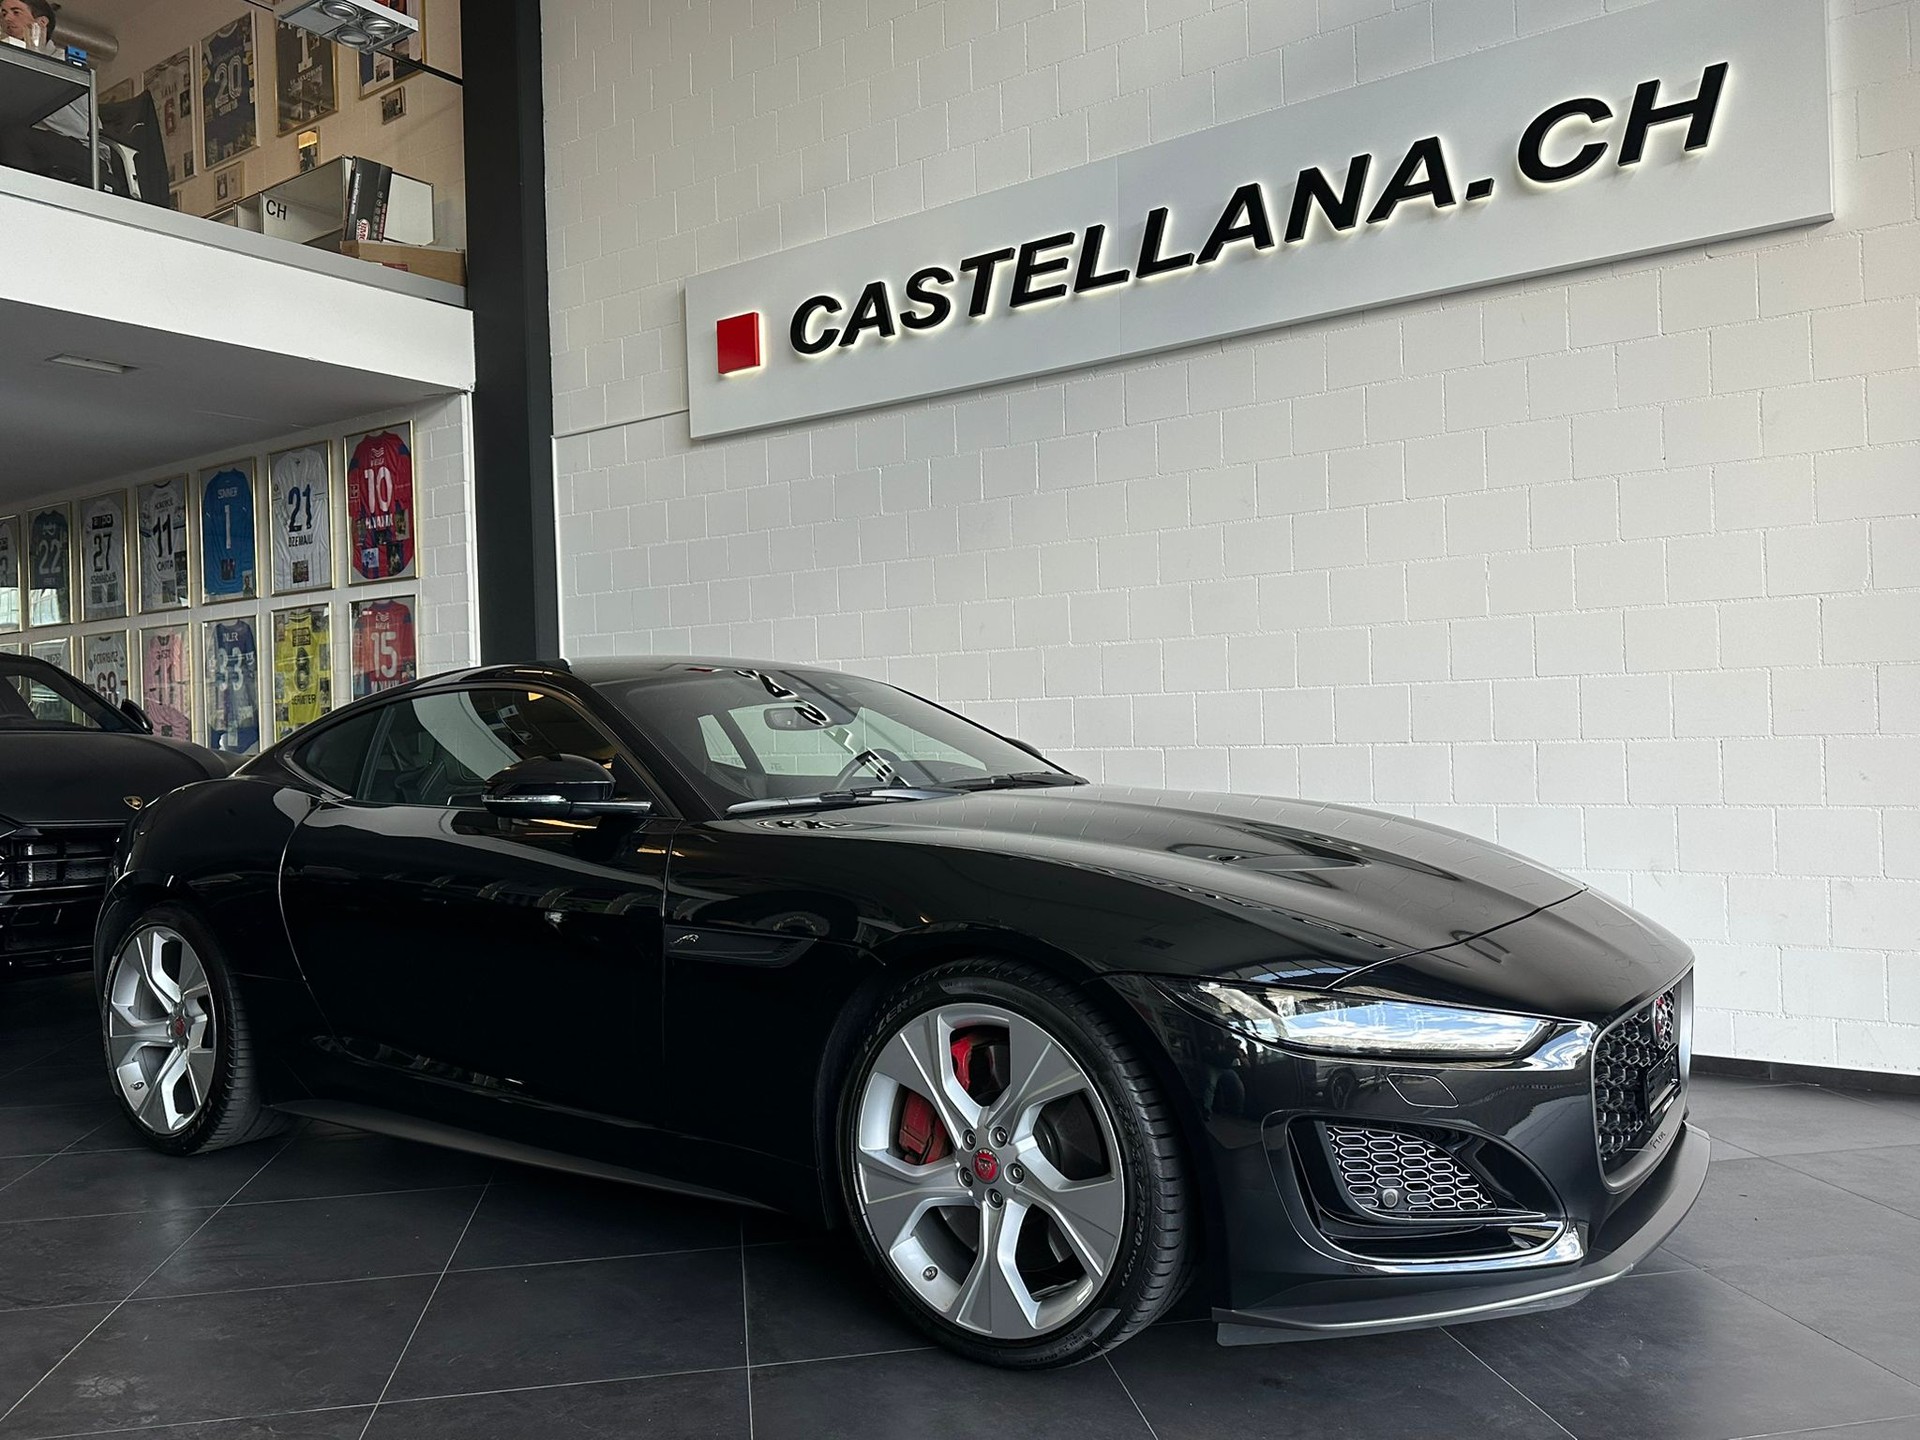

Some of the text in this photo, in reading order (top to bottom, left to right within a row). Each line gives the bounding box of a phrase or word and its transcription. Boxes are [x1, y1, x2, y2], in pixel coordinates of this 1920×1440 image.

[214, 55, 242, 109] 20
[266, 199, 287, 220] CH
[791, 62, 1727, 354] CASTELLANA.CH
[288, 484, 312, 532] 21
[364, 466, 393, 514] 10
[153, 514, 172, 557] 11
[224, 504, 231, 549] 1
[39, 539, 61, 575] 22
[93, 532, 112, 572] 27
[217, 647, 243, 691] 33
[371, 631, 397, 678] 15
